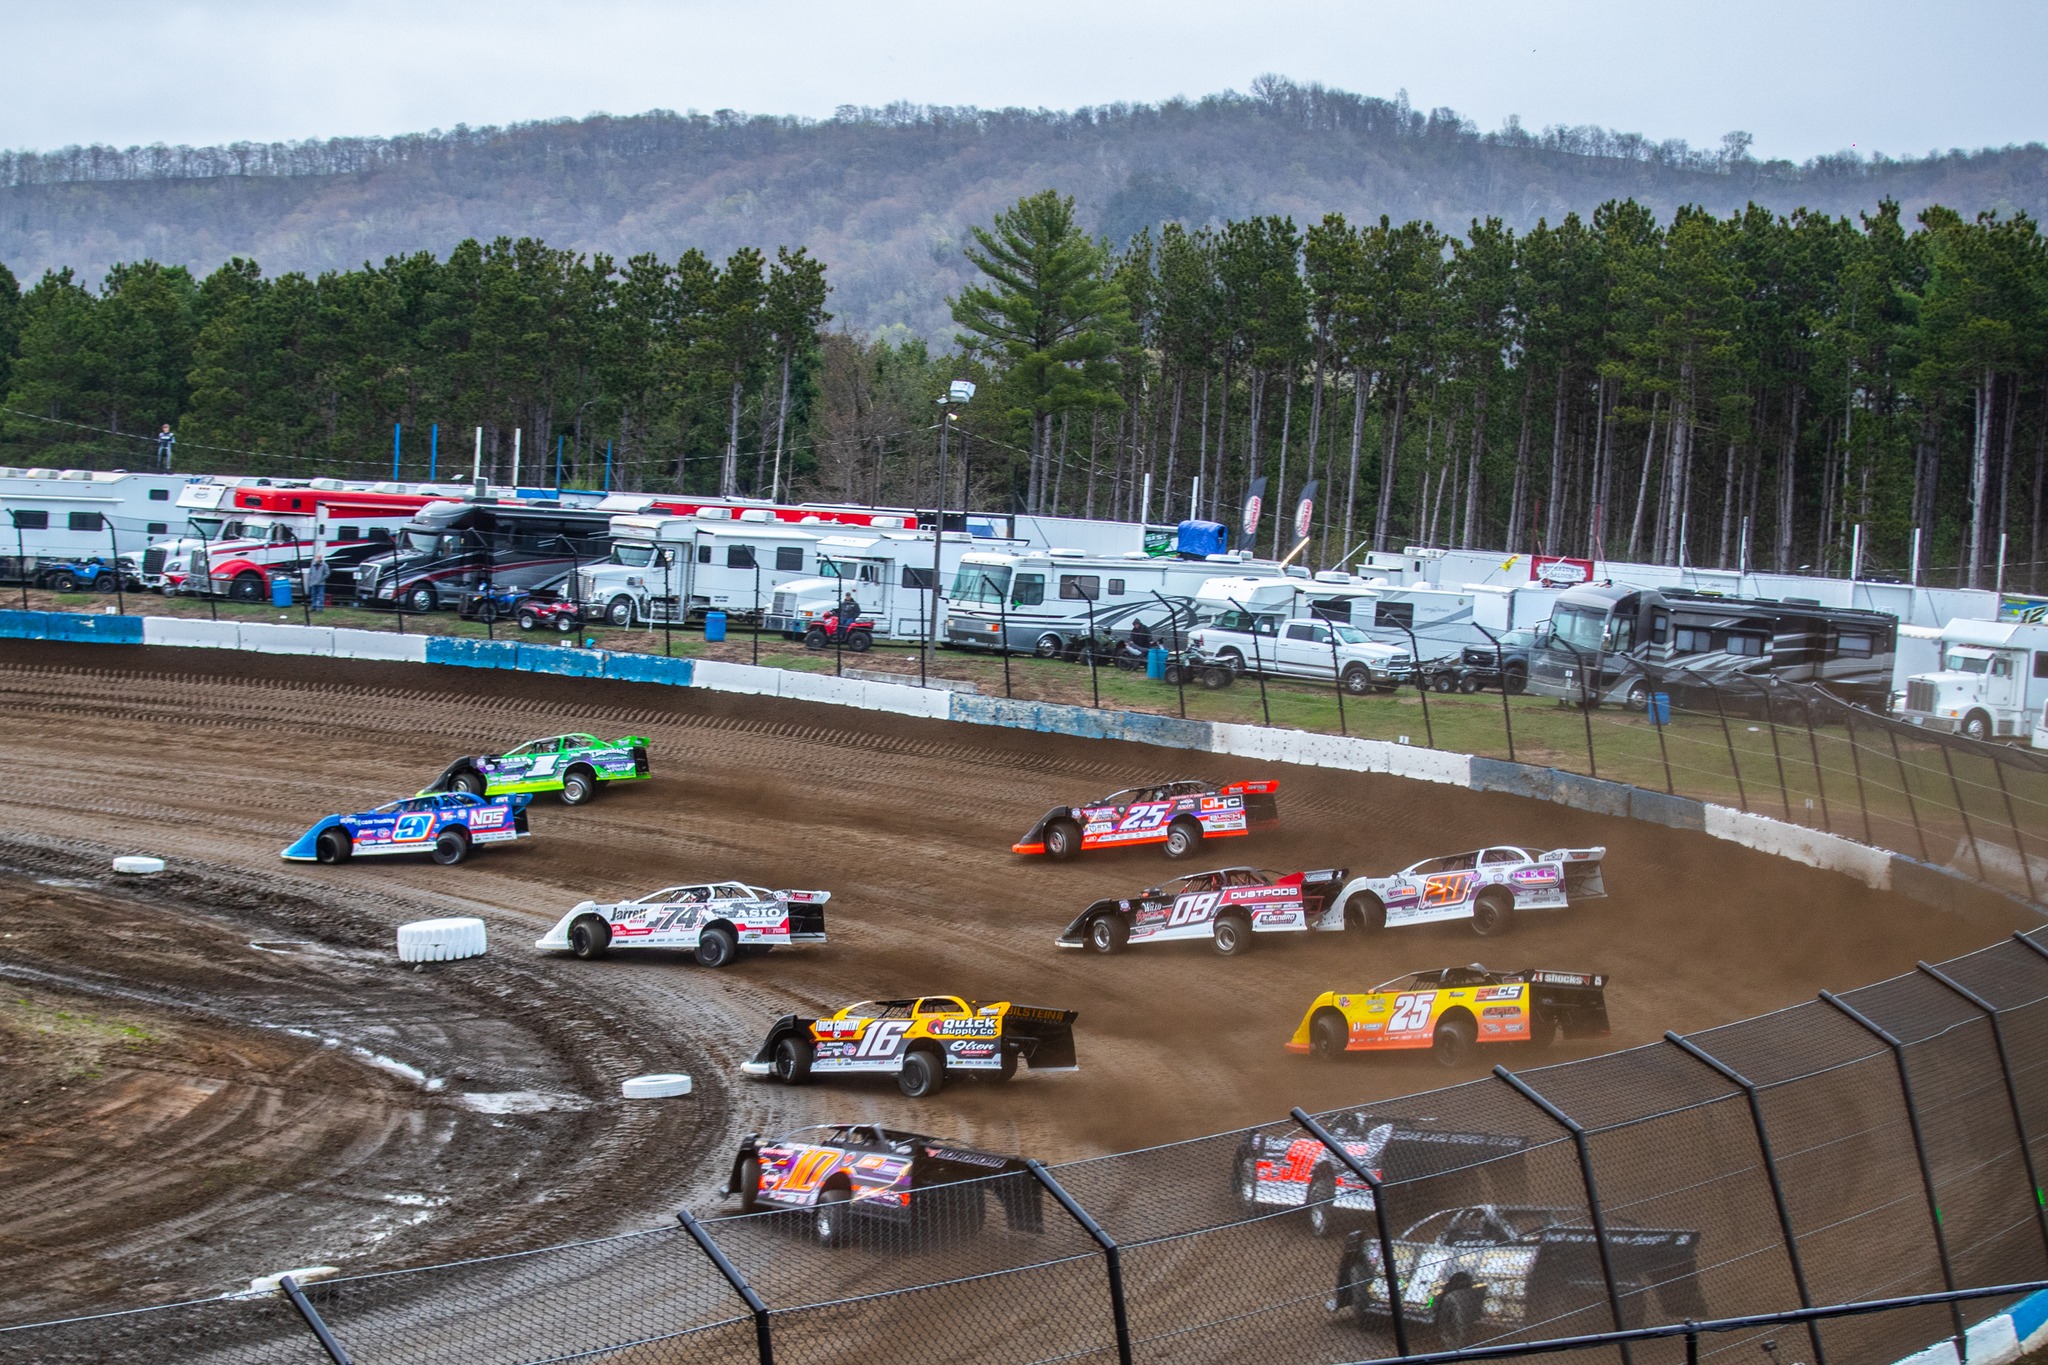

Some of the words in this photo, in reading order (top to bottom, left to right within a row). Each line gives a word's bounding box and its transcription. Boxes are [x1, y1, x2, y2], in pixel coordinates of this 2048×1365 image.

[524, 754, 560, 777] 1
[1203, 797, 1240, 809] JHC
[469, 807, 508, 826] NOS
[1118, 803, 1171, 830] 25
[1230, 887, 1298, 900] DUSTPODS
[610, 907, 648, 923] Jarrett
[1168, 892, 1219, 927] 09
[1544, 973, 1583, 985] shocks
[1387, 994, 1435, 1031] 25
[943, 1017, 996, 1028] Quick
[856, 1021, 913, 1057] 16
[942, 1027, 978, 1036] Supply
[980, 1027, 997, 1036] Co.
[949, 1040, 996, 1051] Olson
